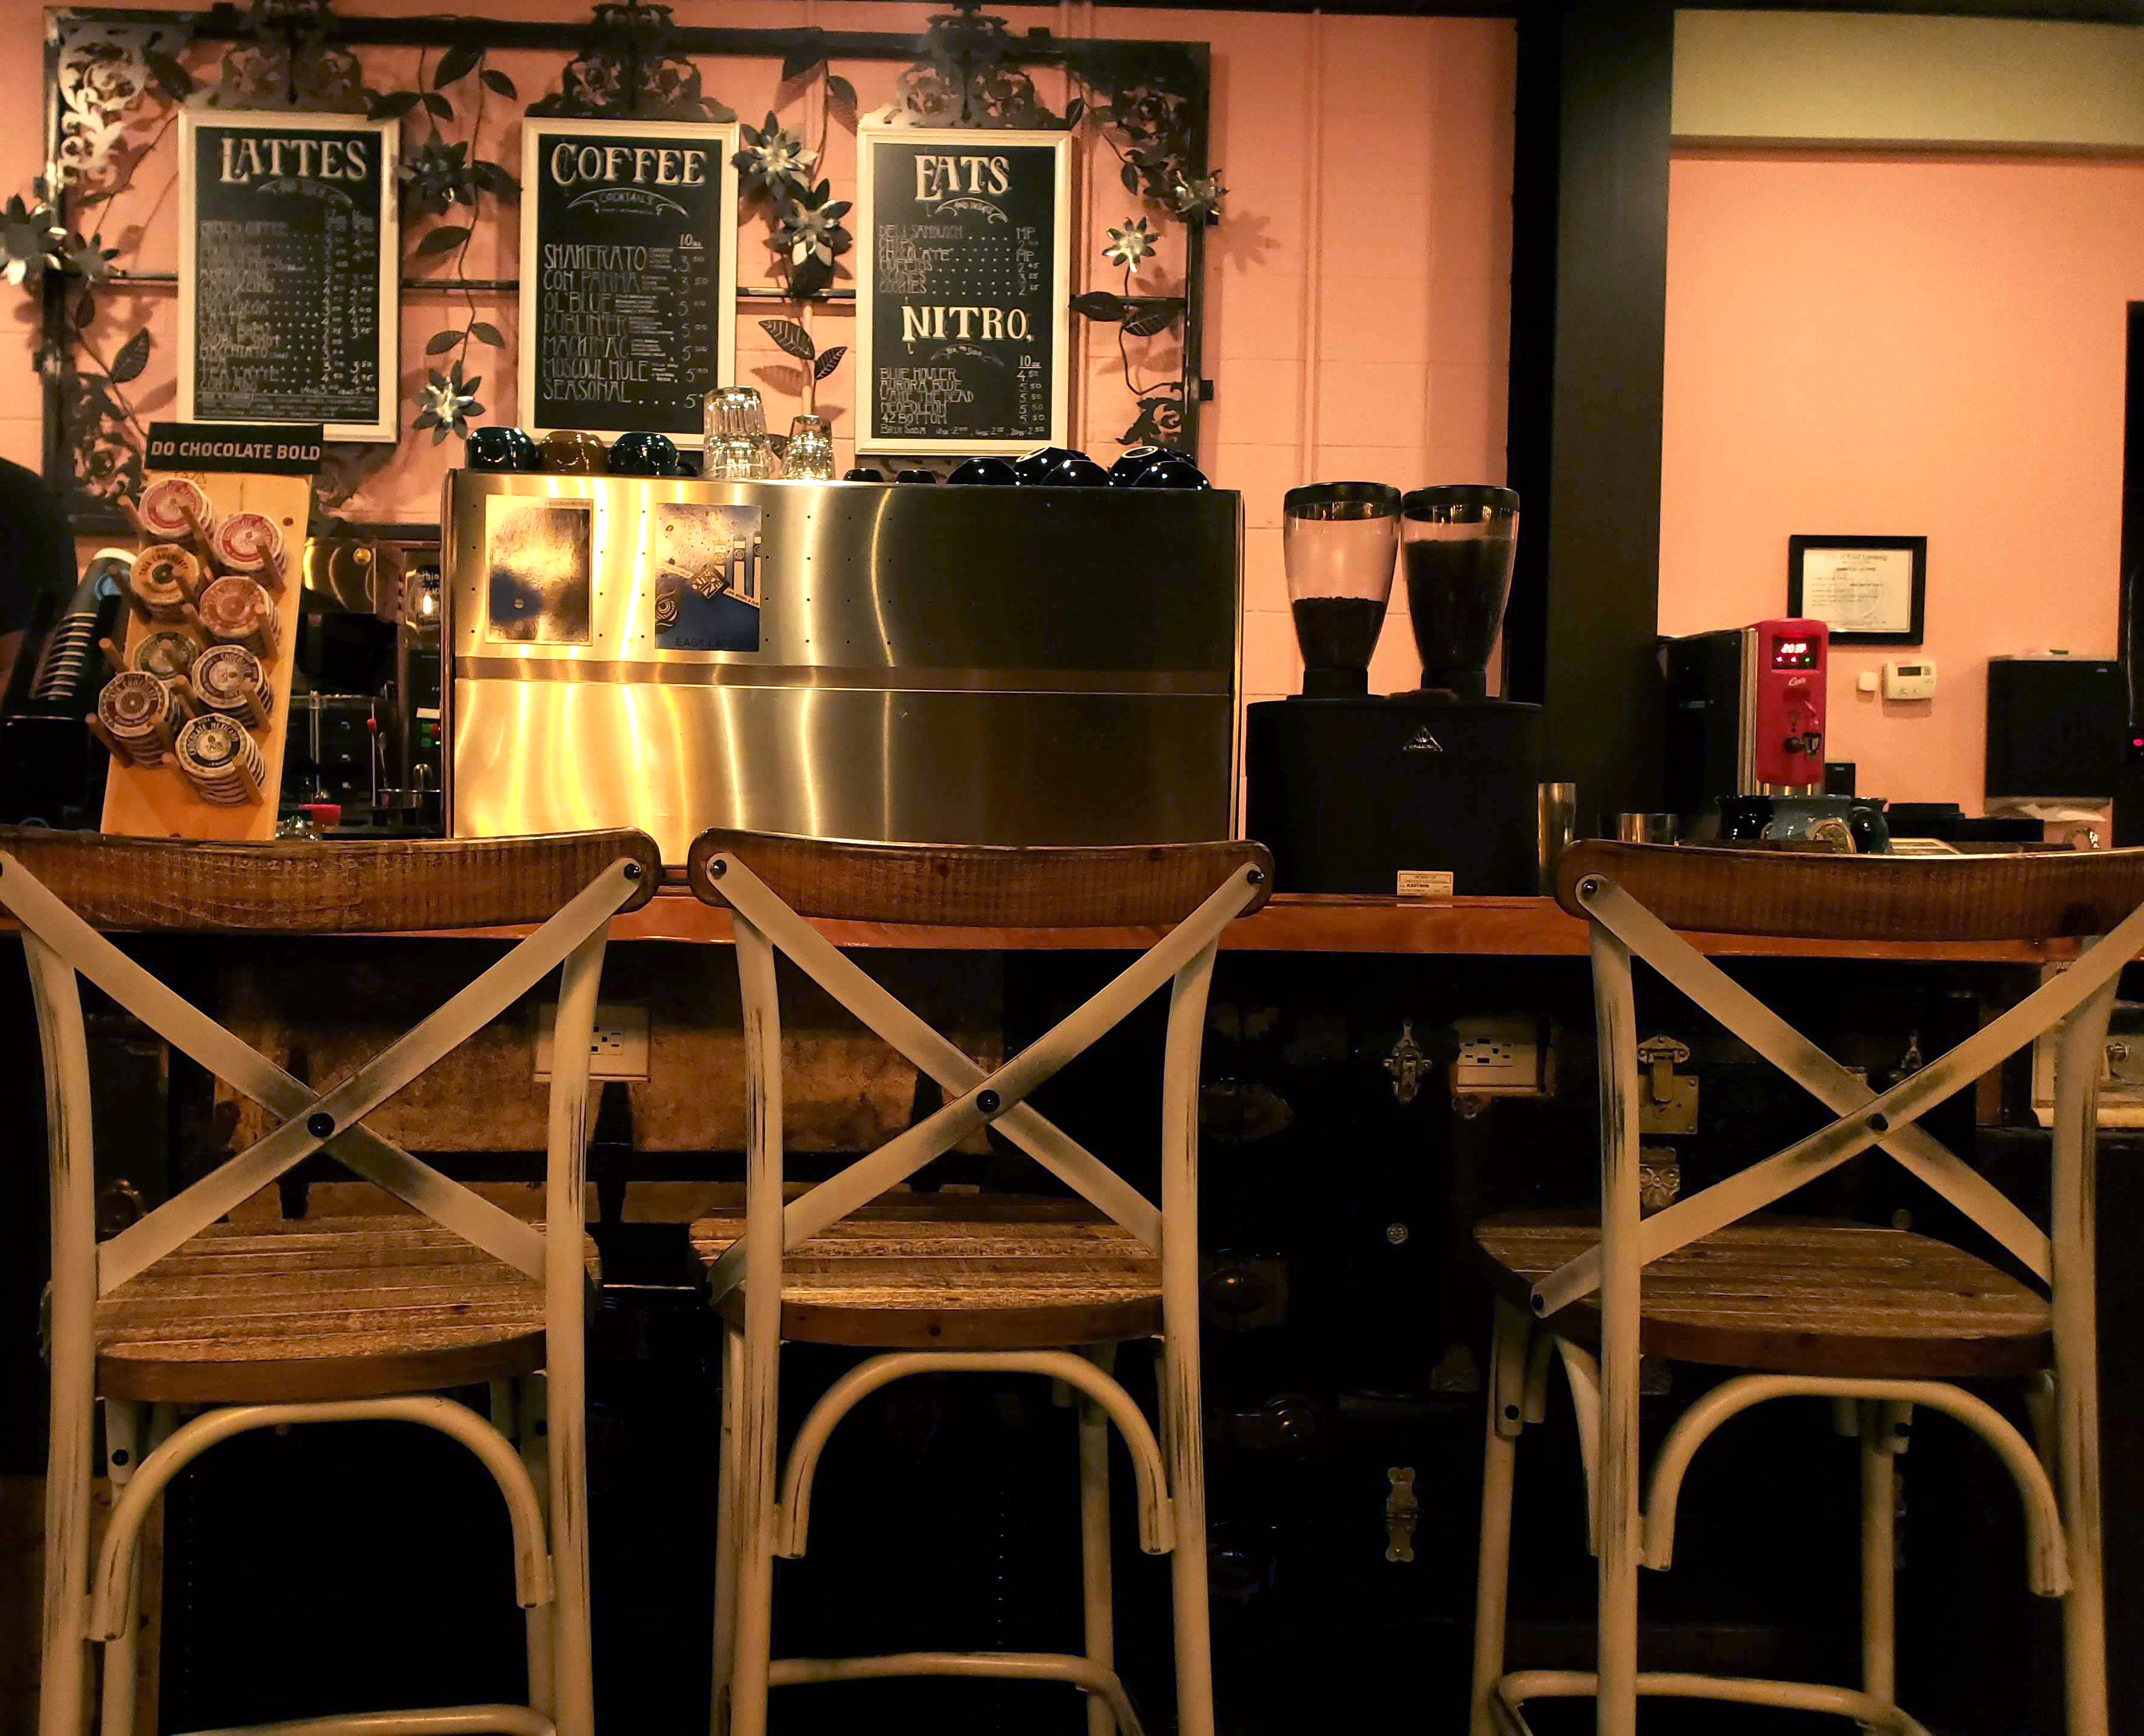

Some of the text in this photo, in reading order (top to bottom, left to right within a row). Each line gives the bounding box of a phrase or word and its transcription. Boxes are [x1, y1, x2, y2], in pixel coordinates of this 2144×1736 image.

[220, 138, 366, 183] LATTES
[551, 142, 706, 187] COFFEE
[914, 155, 1010, 202] EATS
[544, 243, 648, 271] SHAKERATO
[544, 270, 575, 291] CON
[581, 271, 641, 293] PANNA
[569, 291, 611, 314] BLUE
[543, 335, 629, 358] MACKINAC
[608, 360, 649, 382] MULE
[879, 367, 911, 380] BLUE
[543, 378, 632, 403] SEASONAL
[879, 380, 928, 392] AURORA
[881, 412, 897, 424] 42
[898, 412, 948, 425] BOTTOM
[151, 441, 321, 461] DO CHOCOLATE BOLD
